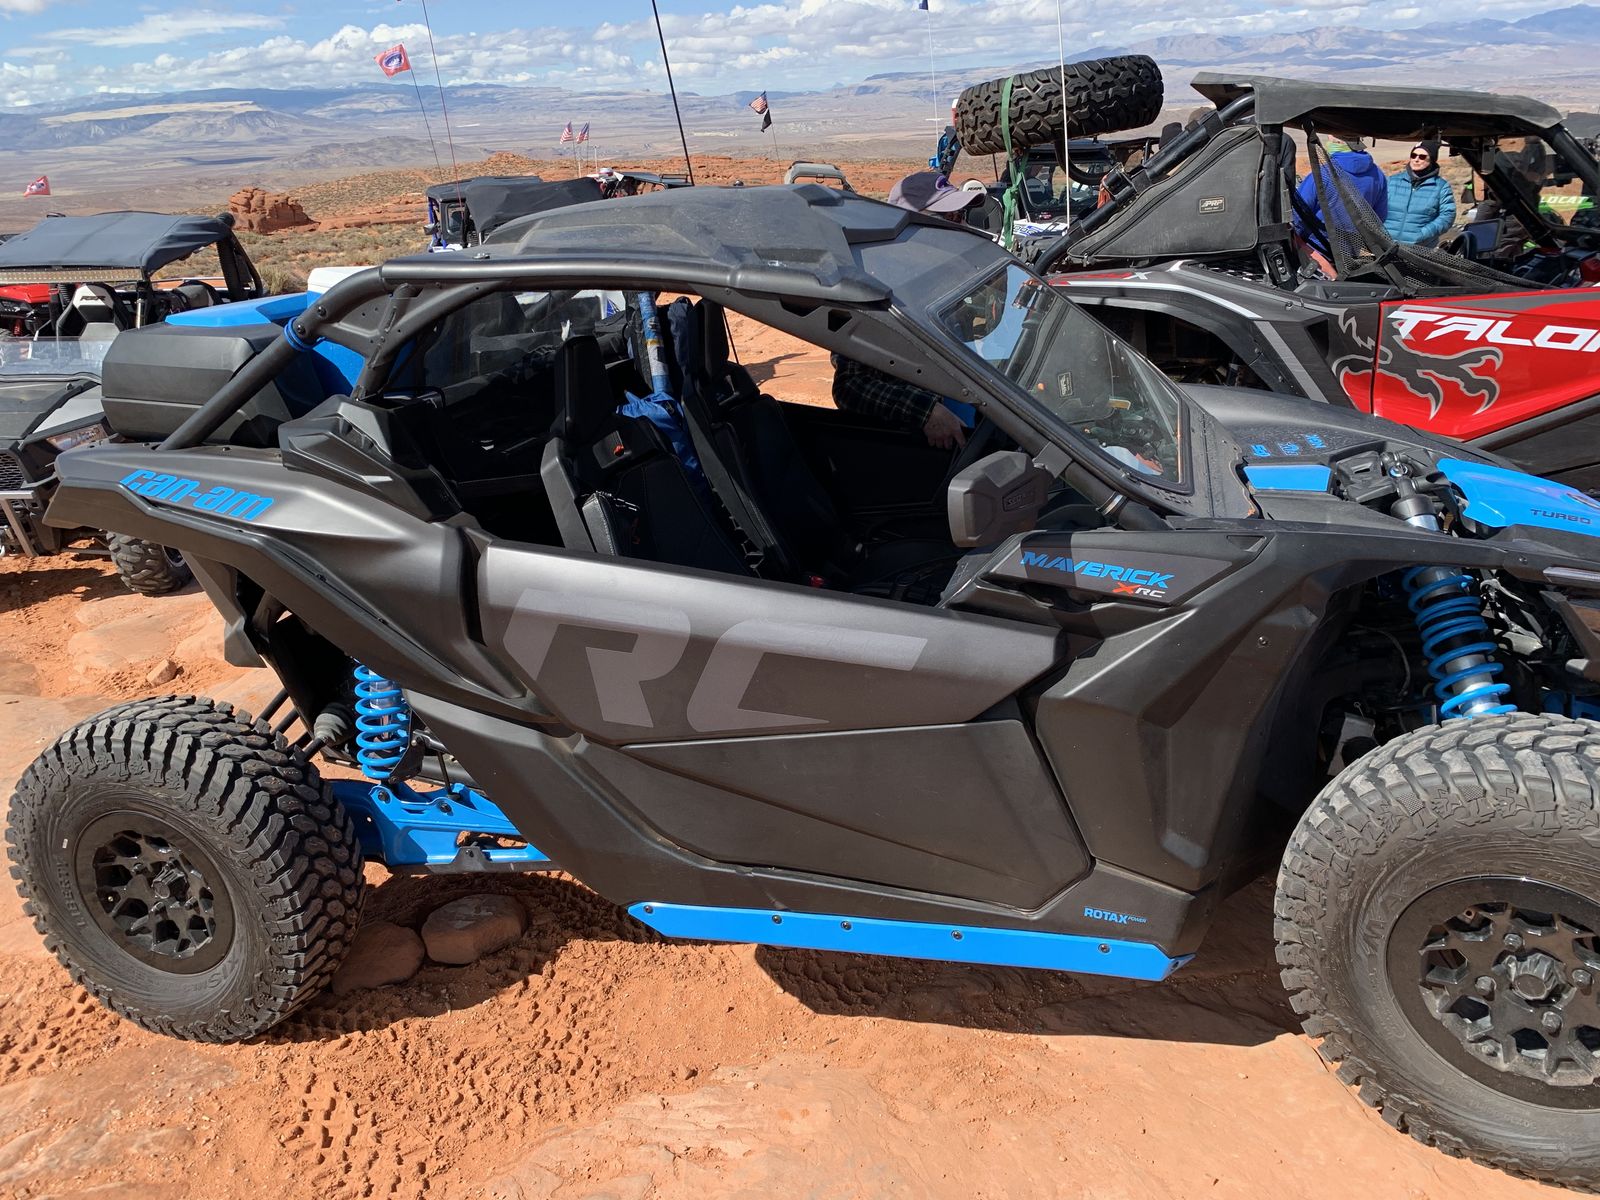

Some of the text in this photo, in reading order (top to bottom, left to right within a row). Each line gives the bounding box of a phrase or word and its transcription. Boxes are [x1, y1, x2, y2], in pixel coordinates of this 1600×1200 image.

[119, 469, 275, 521] can-am
[1530, 508, 1592, 524] TURBO
[1020, 551, 1175, 589] MAVERICK
[503, 588, 928, 732] RC
[1084, 907, 1128, 924] ROTAX
